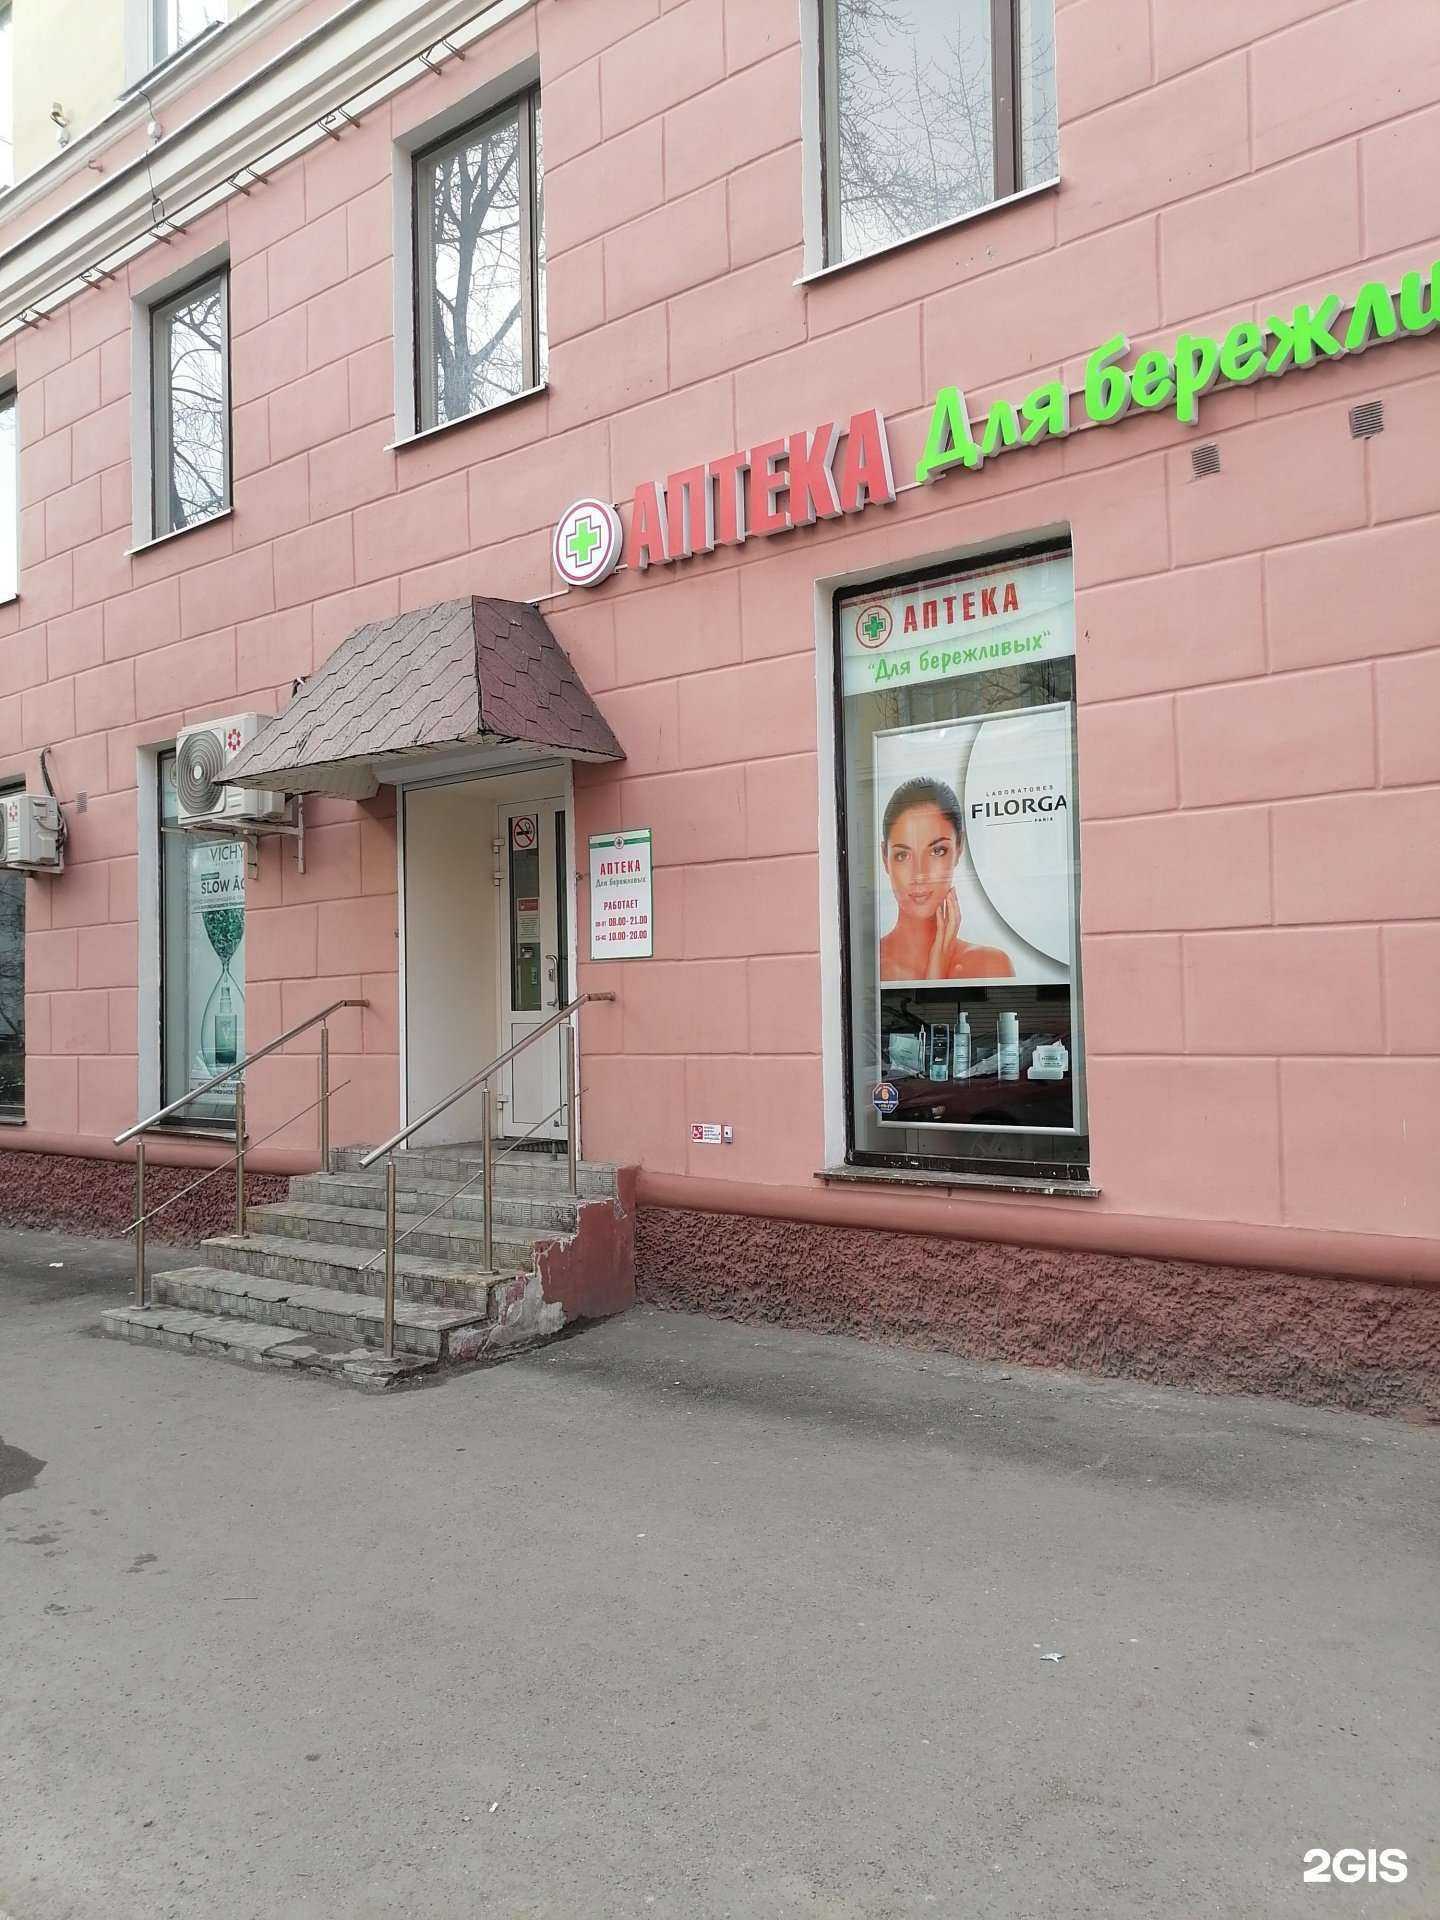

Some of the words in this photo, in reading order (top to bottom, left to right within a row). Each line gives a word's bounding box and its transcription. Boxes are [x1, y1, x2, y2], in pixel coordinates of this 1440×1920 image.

[626, 408, 898, 569] АПТЕКА
[914, 384, 1066, 483] Для
[903, 582, 1019, 633] АПТЕКА
[971, 795, 1066, 819] FILORGA
[600, 860, 640, 875] АПТЕКА
[201, 880, 230, 894] SLOW
[603, 900, 638, 910] РАБОТАЕТ
